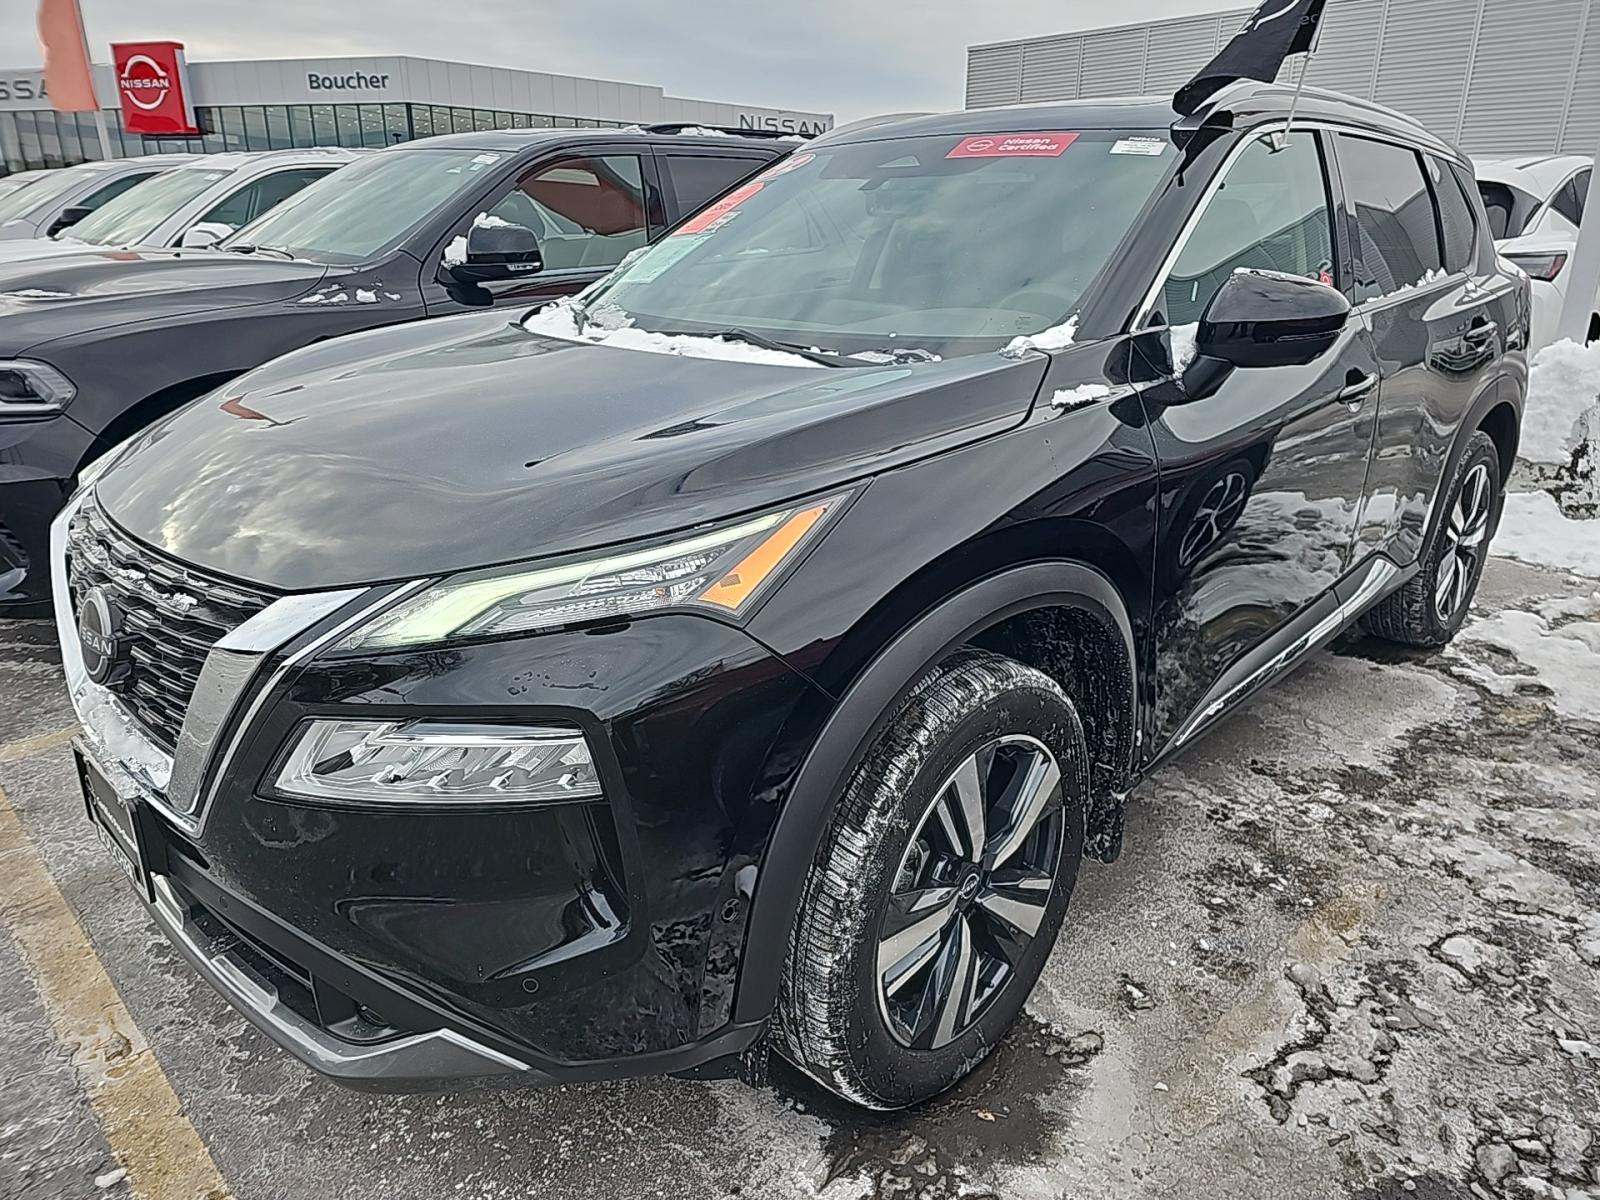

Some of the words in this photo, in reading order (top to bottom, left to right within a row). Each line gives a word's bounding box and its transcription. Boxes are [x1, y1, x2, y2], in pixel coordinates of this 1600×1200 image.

[120, 78, 170, 89] NISSAN
[307, 71, 389, 90] Boucher
[740, 114, 827, 135] NISSAN
[997, 143, 1060, 151] Certified
